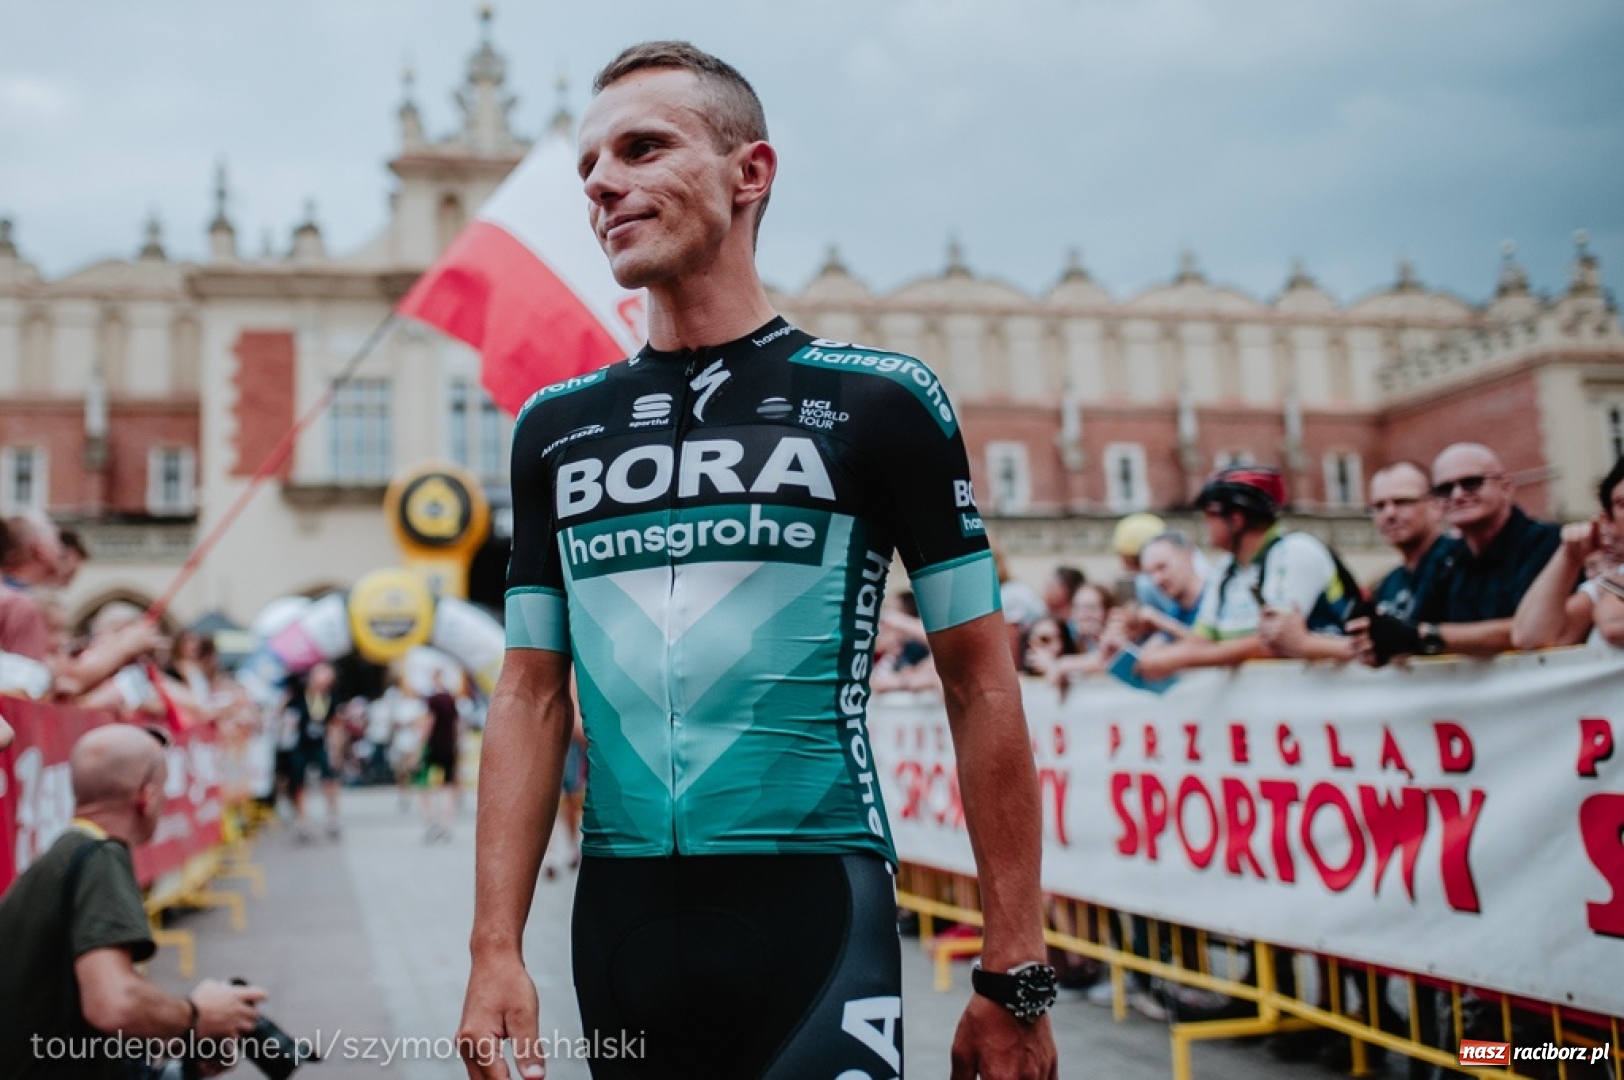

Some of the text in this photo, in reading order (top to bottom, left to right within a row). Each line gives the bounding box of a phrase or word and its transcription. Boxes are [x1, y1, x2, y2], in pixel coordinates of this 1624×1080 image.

[801, 407, 849, 422] WORLD
[802, 399, 831, 410] UCI
[803, 347, 952, 422] hansgrohe
[629, 418, 669, 428] sportful
[799, 415, 834, 430] TOUR
[556, 437, 836, 520] BORA
[566, 504, 816, 565] hansgrohe
[839, 550, 891, 838] hansgrohe
[1111, 772, 1486, 914] SPORTOWY
